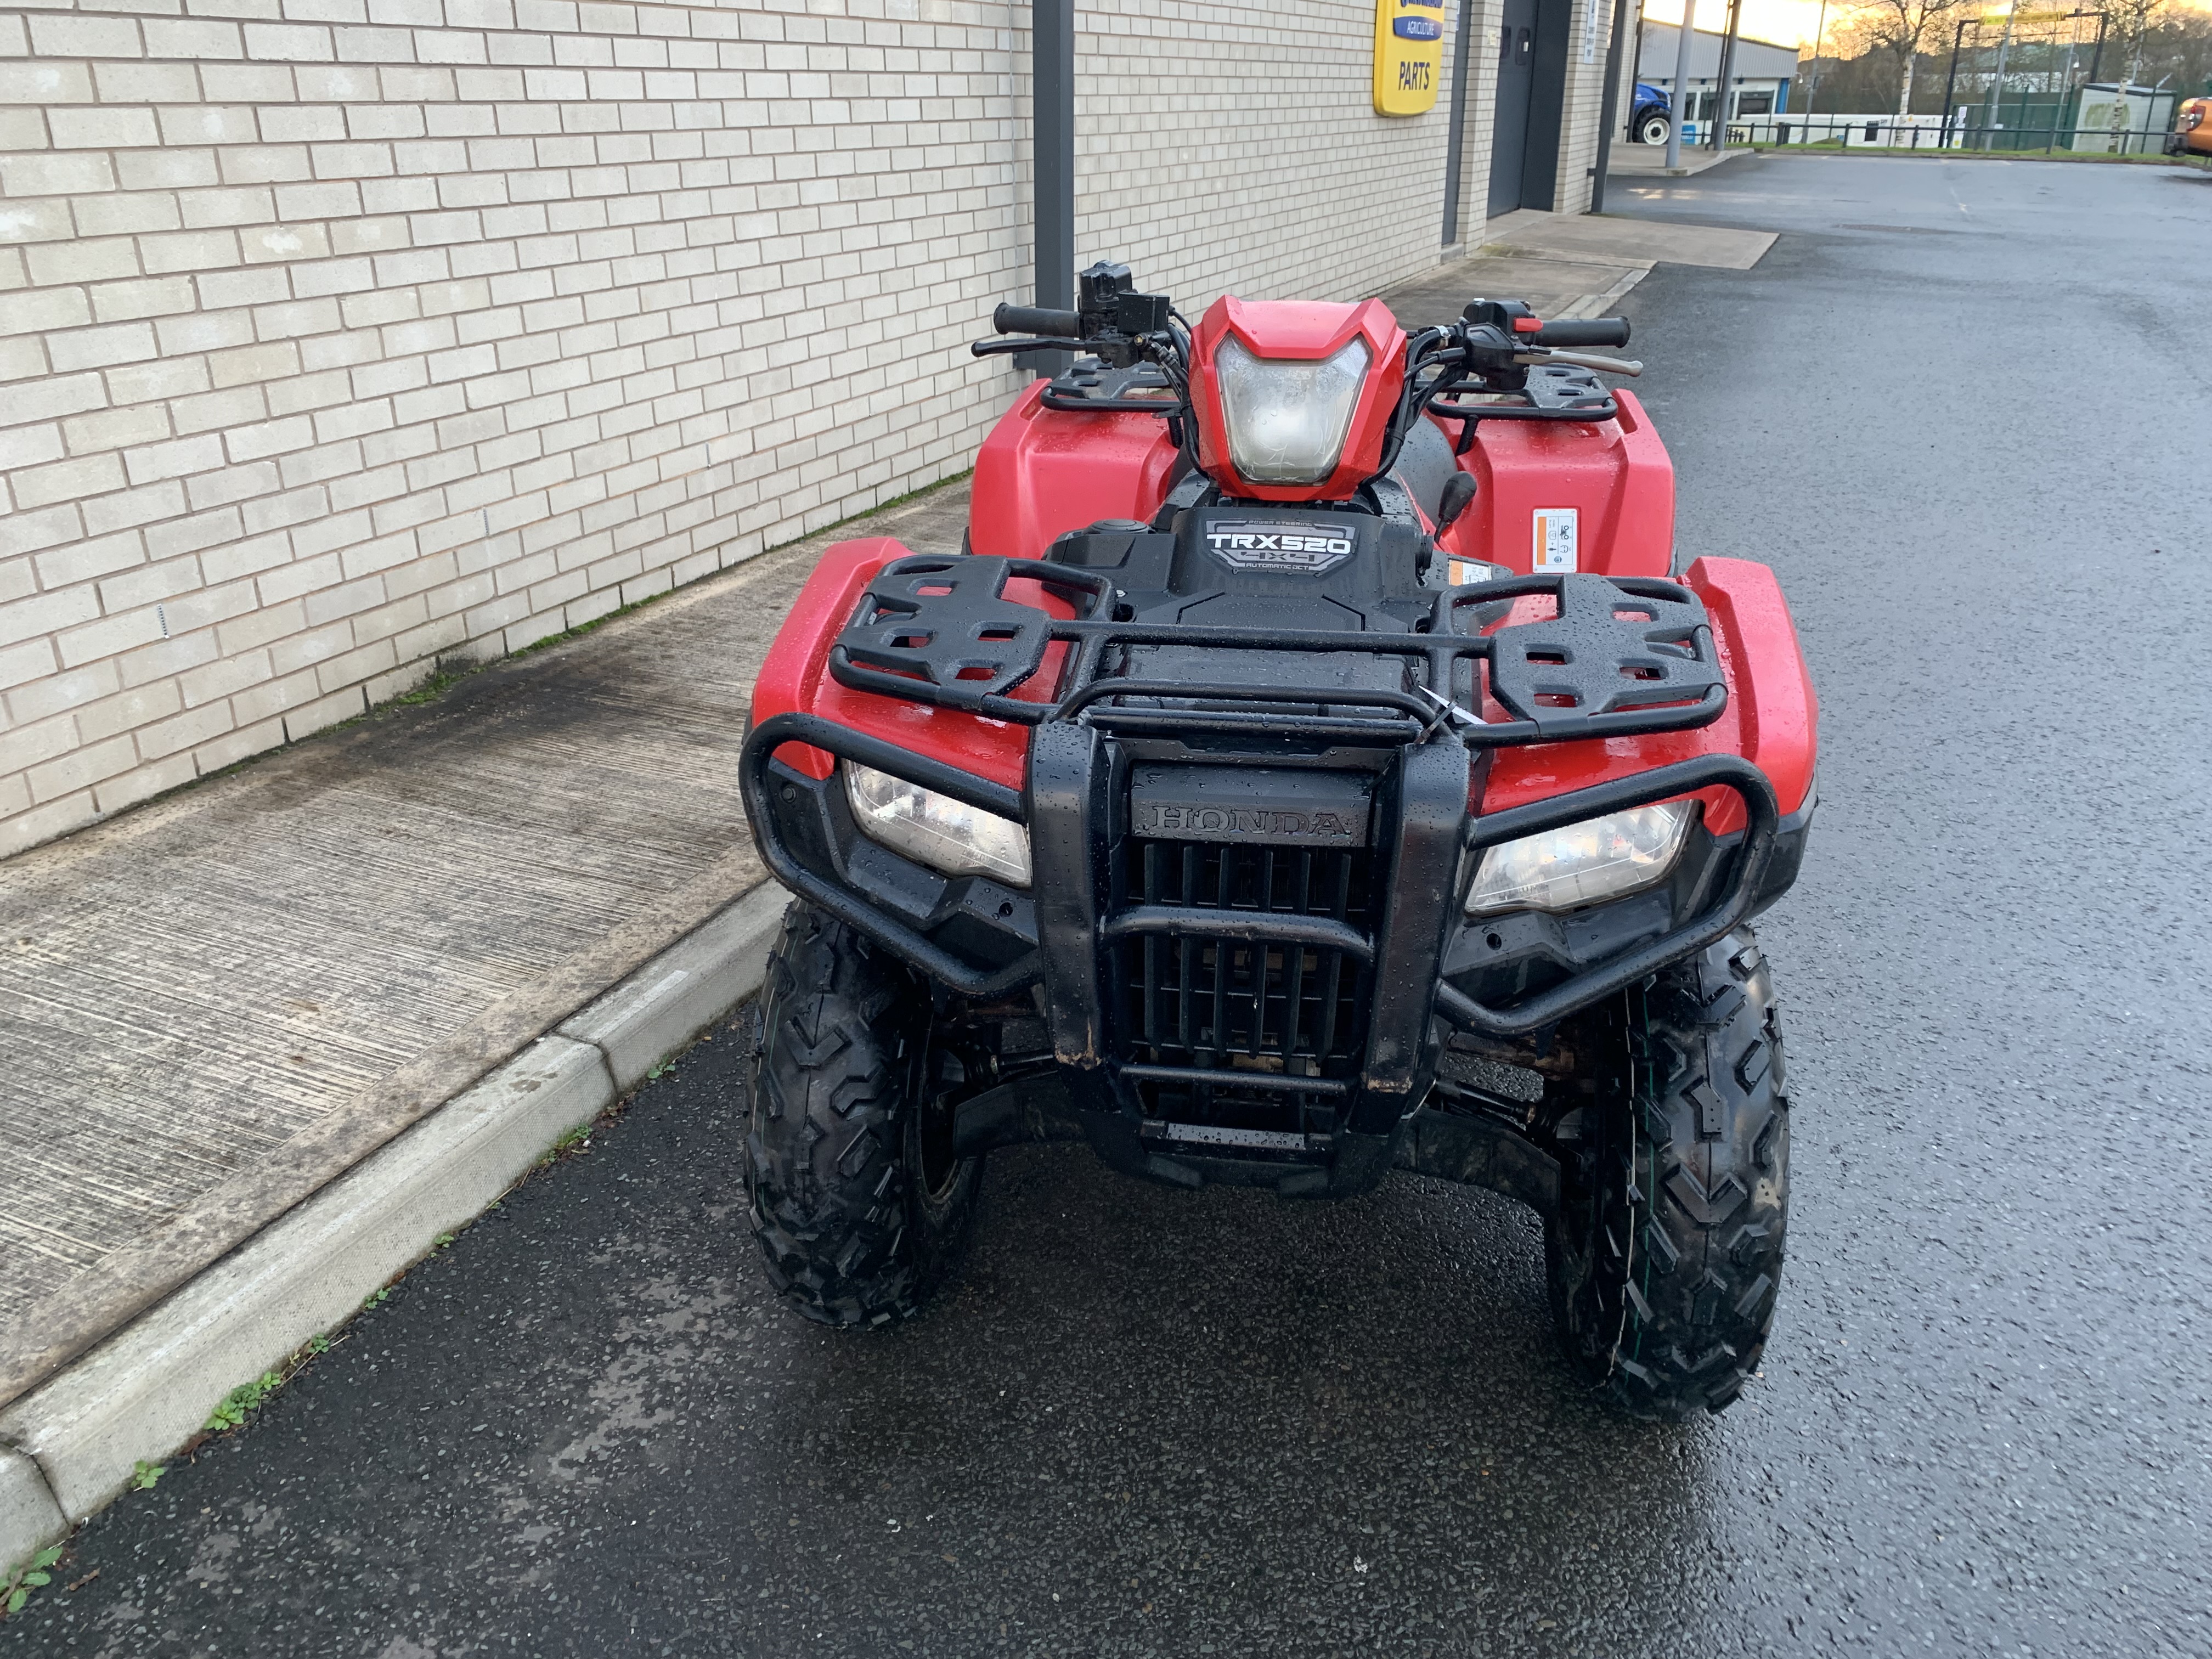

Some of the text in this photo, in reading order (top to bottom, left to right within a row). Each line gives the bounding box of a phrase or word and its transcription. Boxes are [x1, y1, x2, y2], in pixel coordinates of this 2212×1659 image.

[1407, 21, 1434, 36] AGRICULTURE
[1398, 61, 1430, 91] PARTS
[1207, 534, 1351, 554] TRX520
[1152, 806, 1351, 837] HONDA
